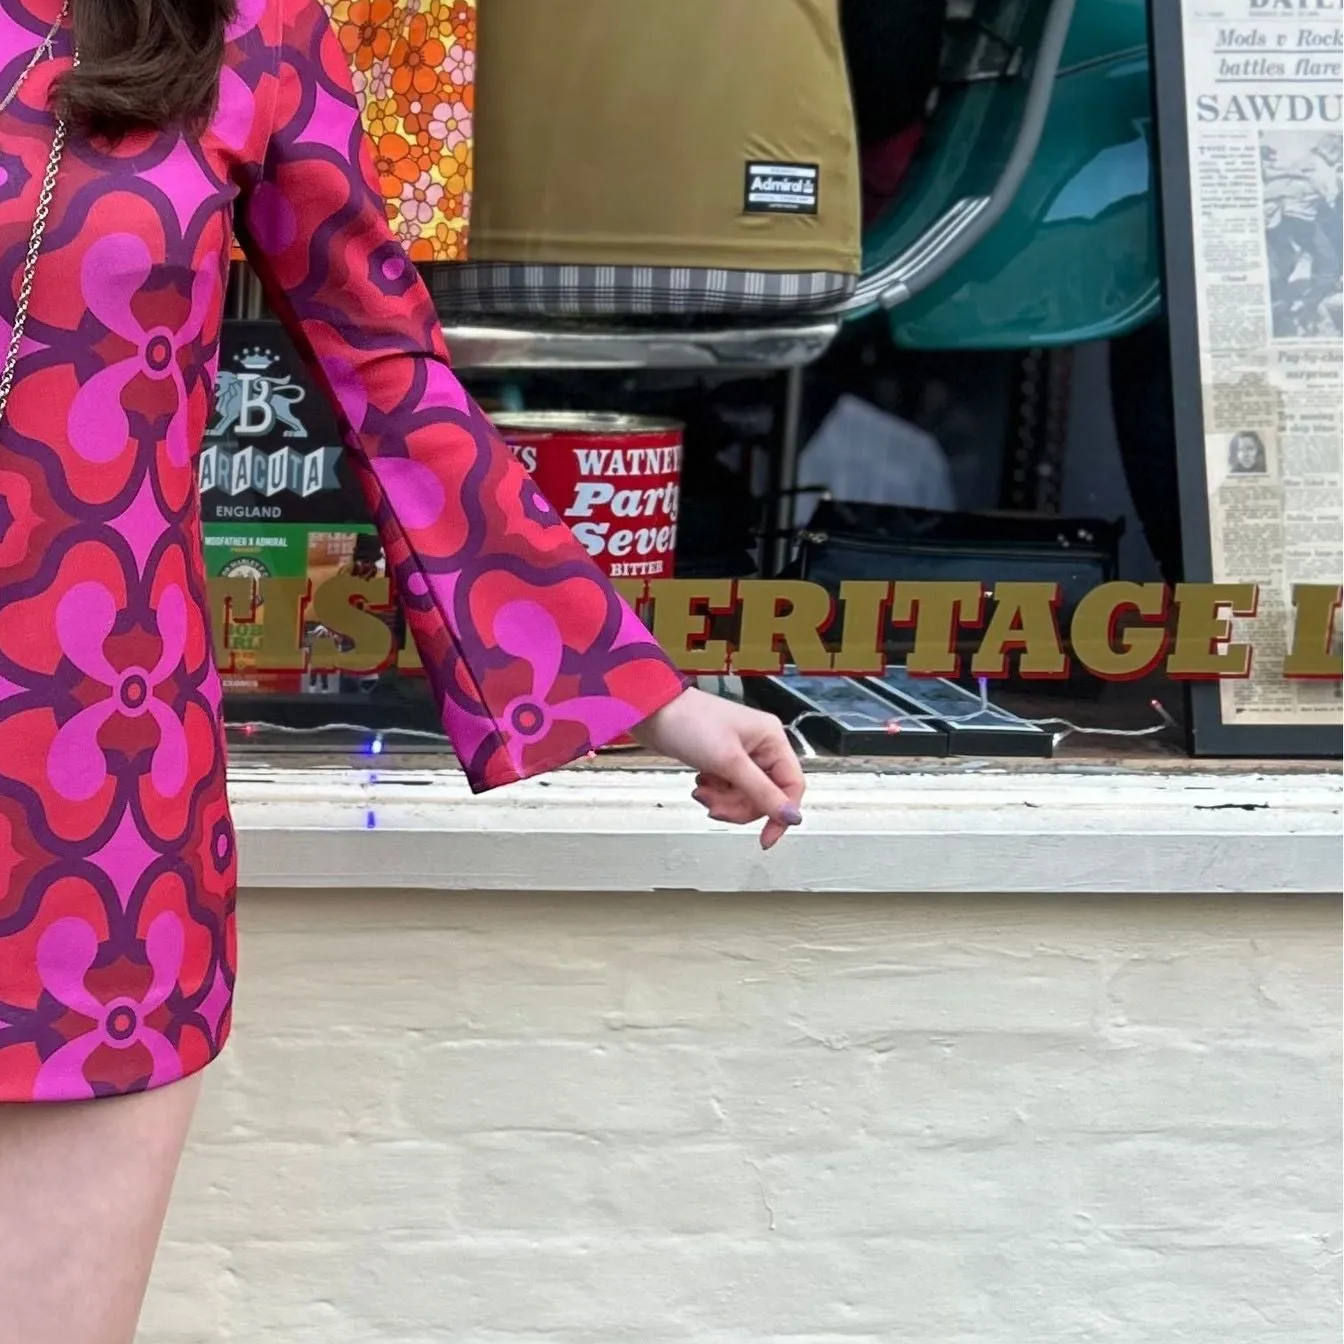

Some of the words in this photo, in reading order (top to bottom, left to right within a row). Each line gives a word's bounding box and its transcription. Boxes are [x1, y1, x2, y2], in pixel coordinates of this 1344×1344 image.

[1215, 28, 1267, 47] Mods
[1276, 35, 1287, 47] v
[1218, 59, 1286, 76] battles
[1294, 57, 1342, 76] flare
[1196, 94, 1343, 123] SAWDU
[750, 175, 803, 193] Admiral
[199, 452, 320, 493] ARACUTA
[564, 481, 679, 522] Party
[216, 505, 282, 518] ENGLAND
[255, 537, 289, 548] ADMIRAL
[609, 560, 664, 577] BITTER
[601, 578, 1261, 680] ERITAGE
